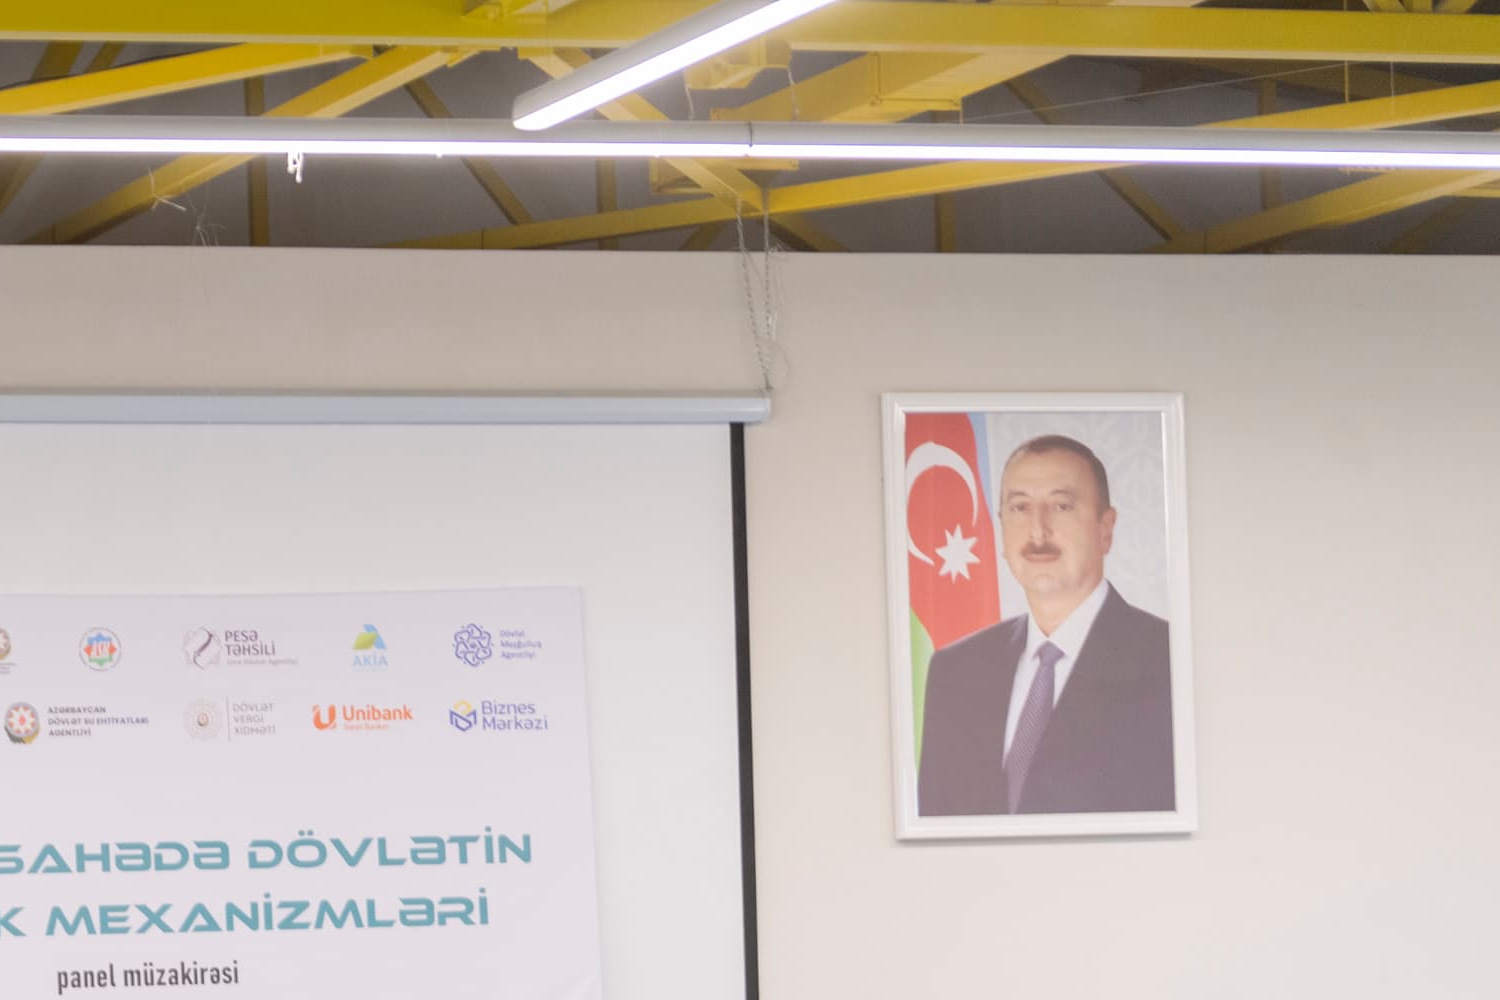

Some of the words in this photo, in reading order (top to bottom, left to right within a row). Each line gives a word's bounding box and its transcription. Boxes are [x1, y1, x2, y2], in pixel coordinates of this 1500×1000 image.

[224, 641, 276, 656] TƏHSİLİ
[342, 703, 414, 722] Unibank
[481, 700, 536, 716] Biznes
[482, 714, 549, 731] Mərkəzi
[247, 826, 533, 870] DÖVLƏTİN
[45, 887, 490, 936] MEXANİZMLƏRİ
[57, 962, 116, 996] panel
[123, 960, 240, 987] müzakirəsi
